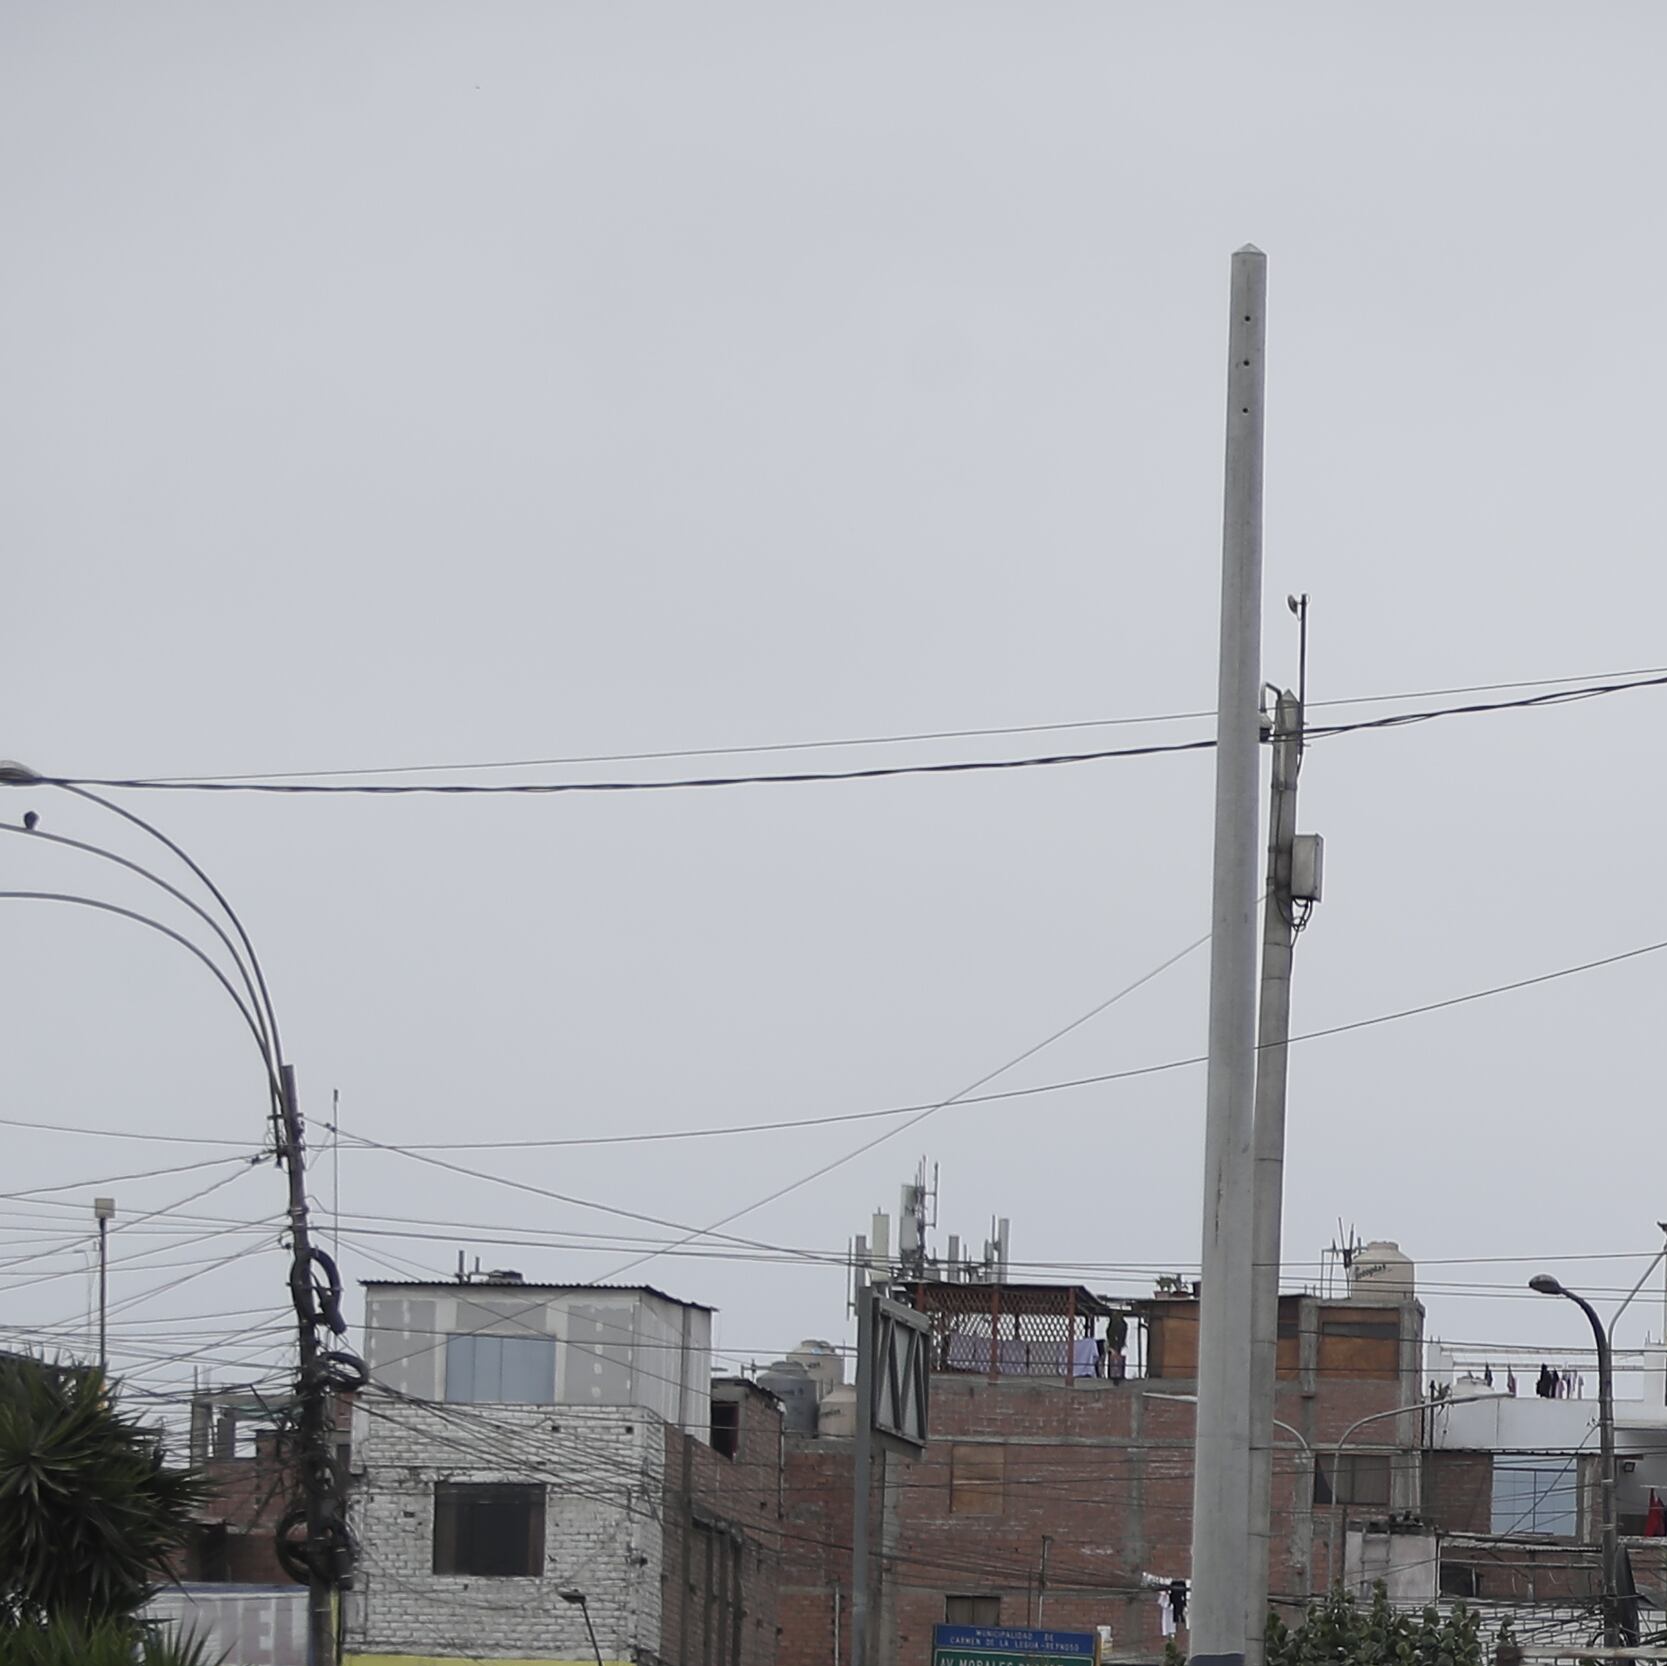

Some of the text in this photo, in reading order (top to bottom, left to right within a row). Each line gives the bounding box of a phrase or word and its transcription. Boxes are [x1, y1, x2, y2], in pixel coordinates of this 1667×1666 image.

[975, 1629, 1054, 1642] MUNICIPALIDAD DE
[950, 1636, 981, 1645] CARMEN
[985, 1638, 995, 1647] DE
[999, 1639, 1009, 1648] LA
